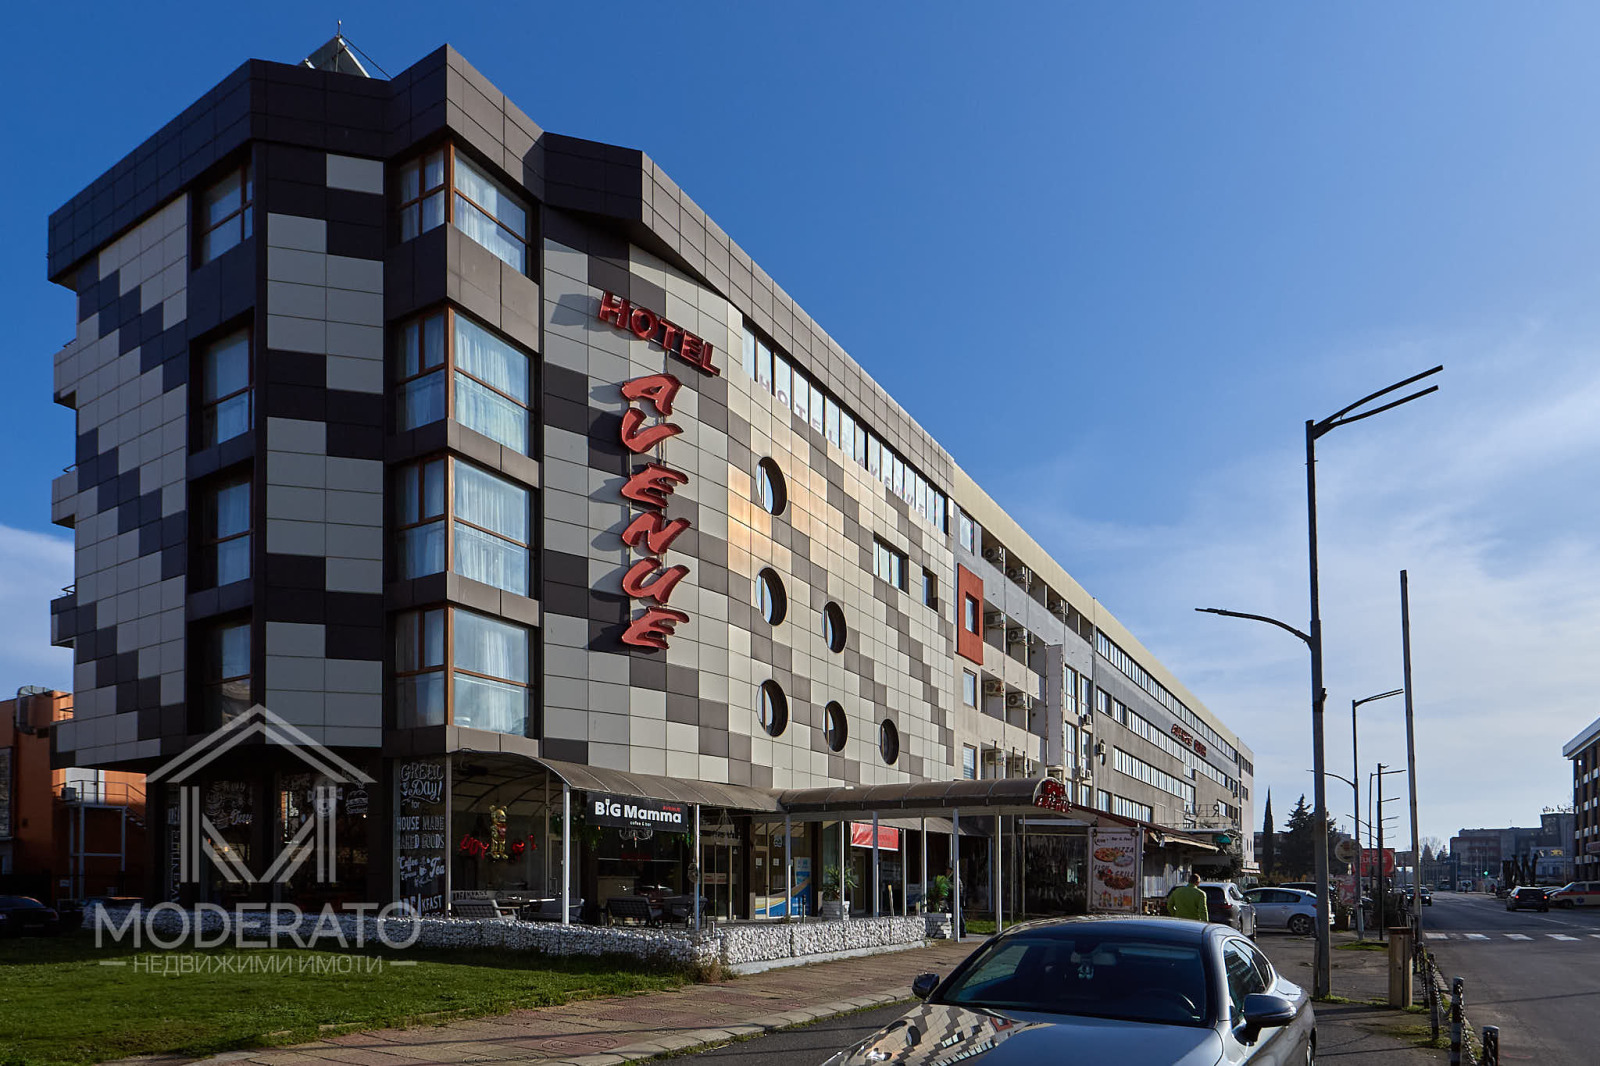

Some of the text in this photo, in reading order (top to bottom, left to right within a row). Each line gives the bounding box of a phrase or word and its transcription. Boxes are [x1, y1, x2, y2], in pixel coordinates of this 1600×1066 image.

[599, 290, 720, 376] HOTEL
[758, 374, 926, 514] HOTEL AVENUE
[621, 373, 691, 650] AVENUE
[623, 804, 682, 824] Mamma
